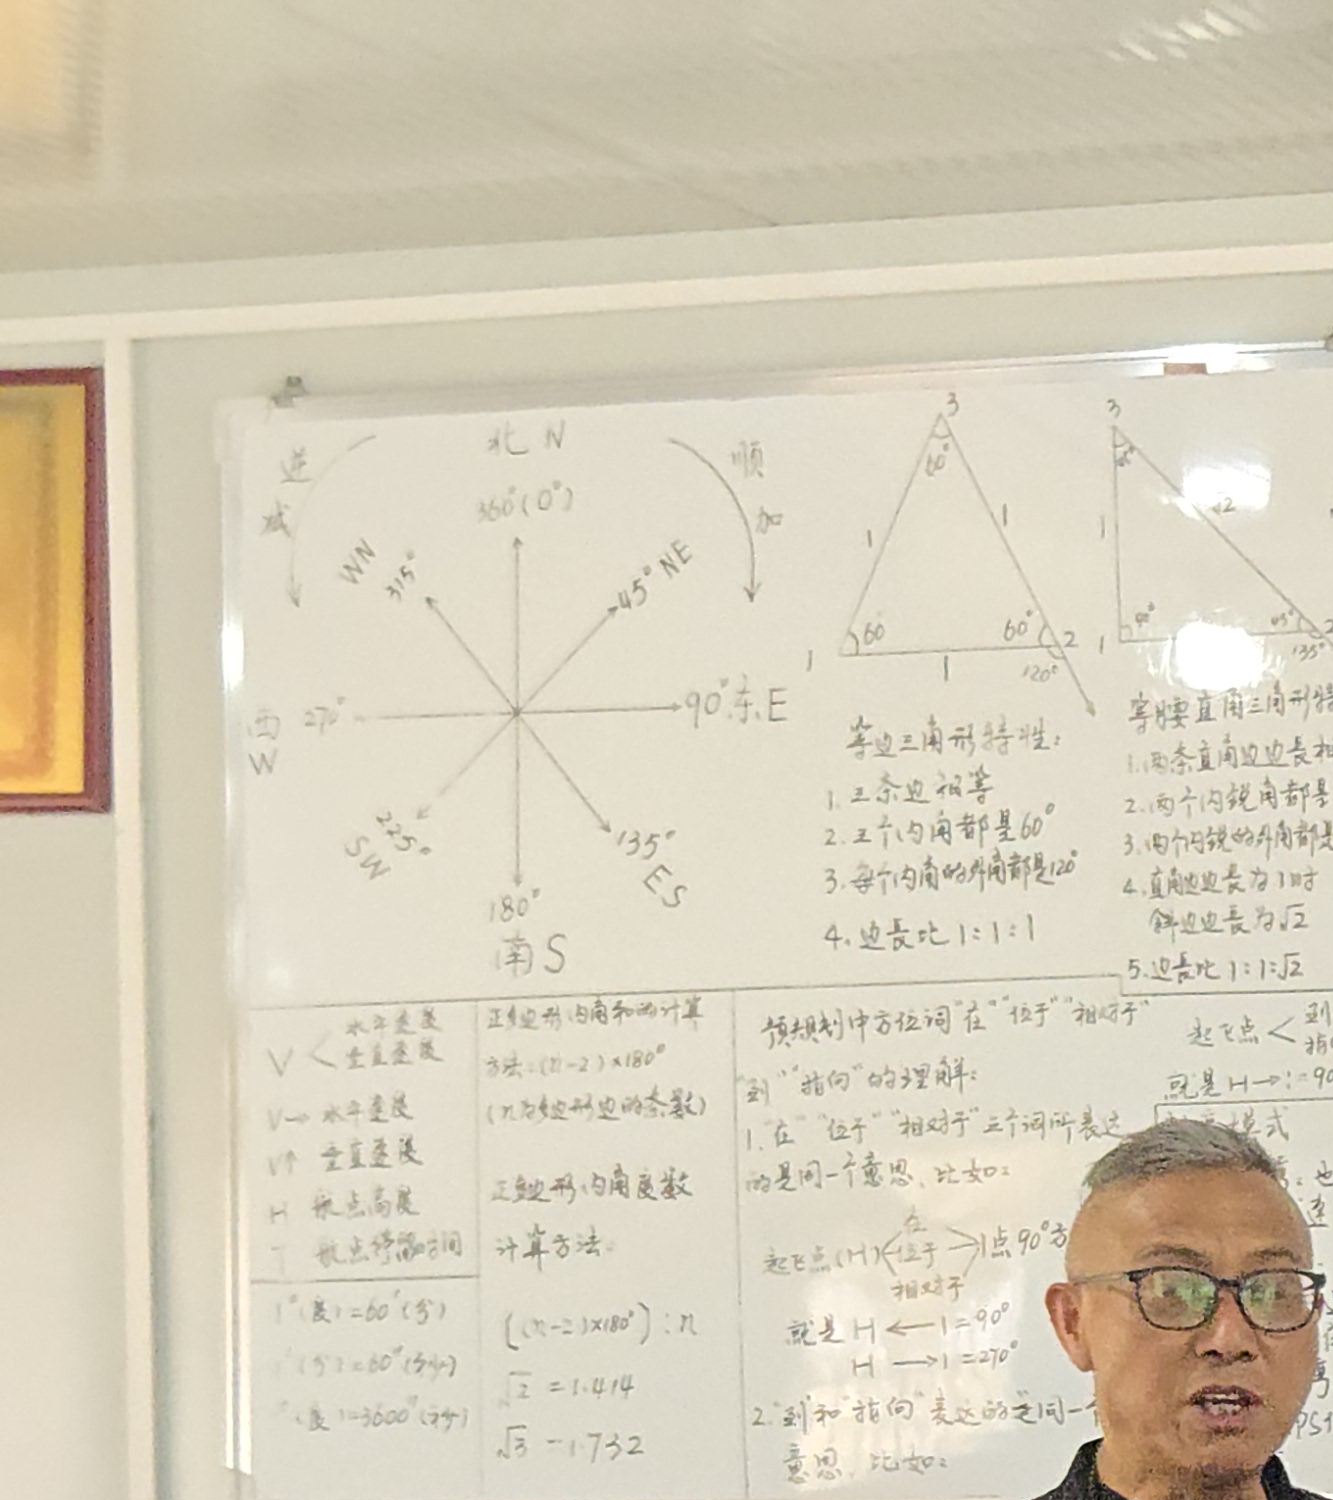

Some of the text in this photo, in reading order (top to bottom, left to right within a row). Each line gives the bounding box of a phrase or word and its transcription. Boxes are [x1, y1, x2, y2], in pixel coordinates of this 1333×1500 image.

[945, 395, 960, 416] 3
[1106, 398, 1122, 420] 3
[486, 421, 564, 455] 北 N
[658, 538, 695, 579] NE
[1062, 629, 1078, 649] 2
[248, 752, 278, 776] W
[344, 834, 392, 882] SW
[617, 829, 677, 861] 135°
[642, 863, 689, 909] ES
[488, 887, 541, 924] 180°
[494, 929, 568, 977] 南 S
[890, 1274, 965, 1303] 相对于
